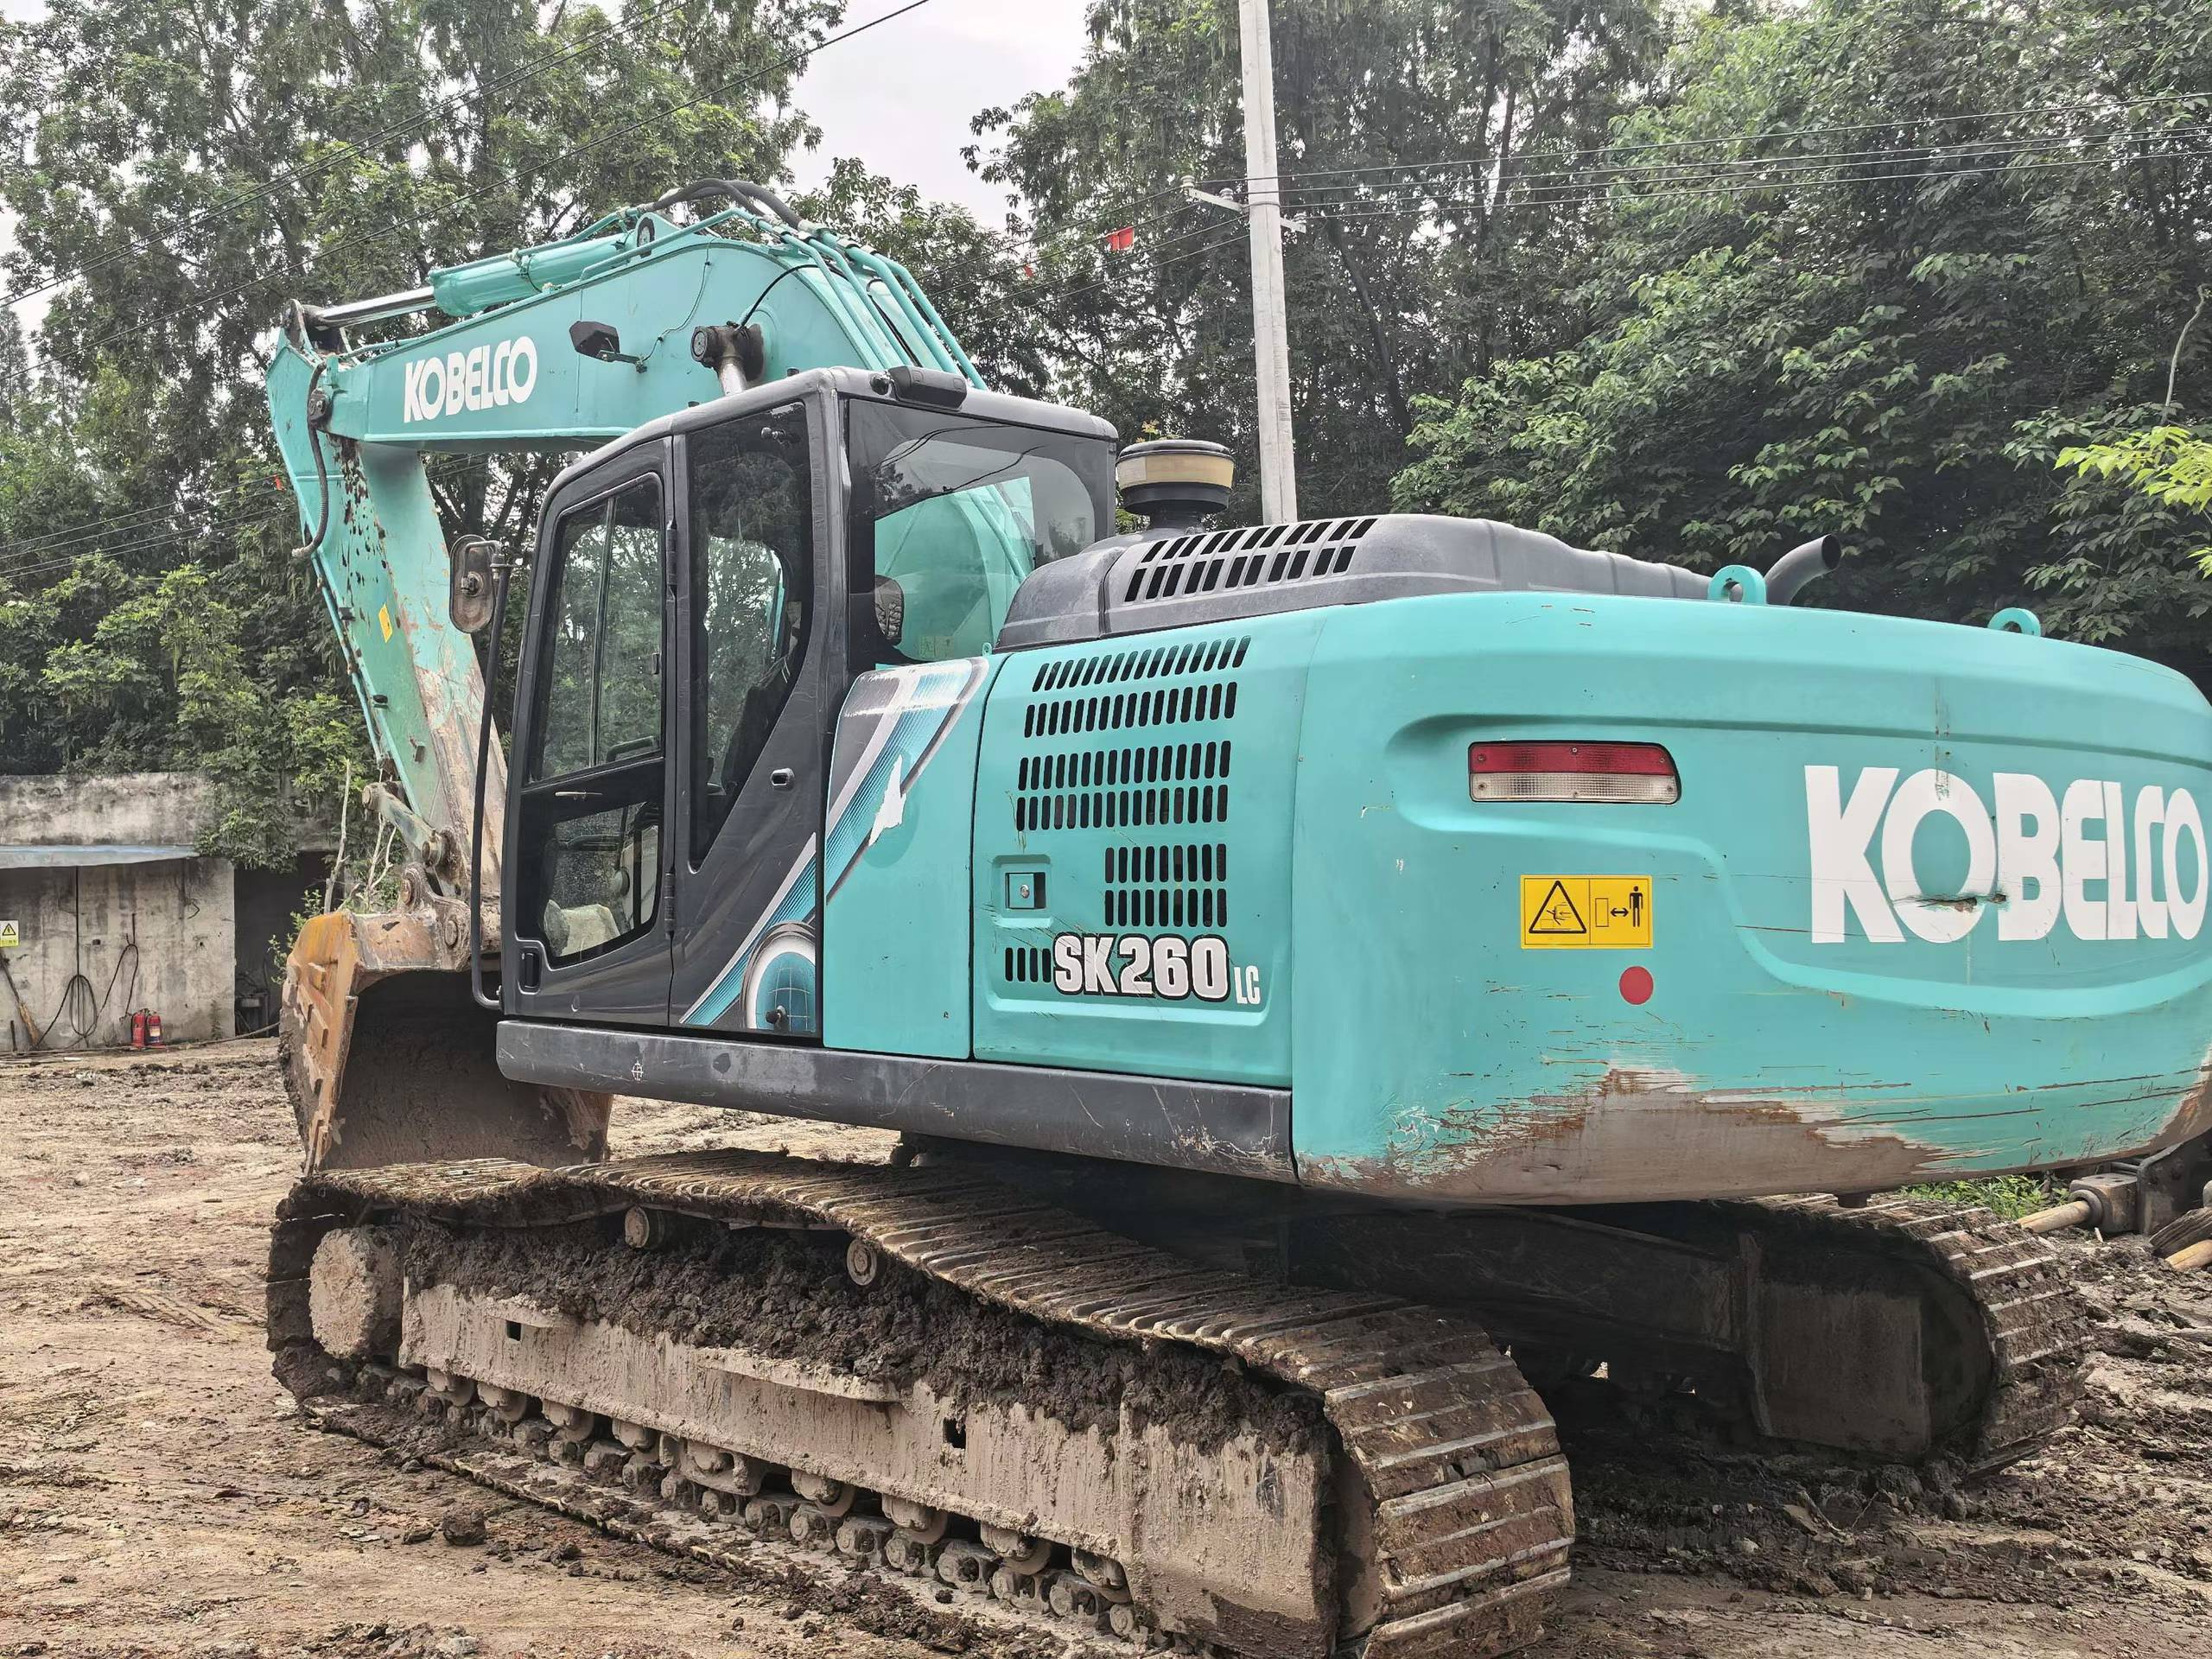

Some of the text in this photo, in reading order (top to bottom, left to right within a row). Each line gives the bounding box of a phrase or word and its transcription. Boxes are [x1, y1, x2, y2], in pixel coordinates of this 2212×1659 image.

[404, 336, 537, 423] KOBELCO
[1804, 765, 2209, 944] KOBELCO
[1052, 931, 1261, 1005] SK260 LC
